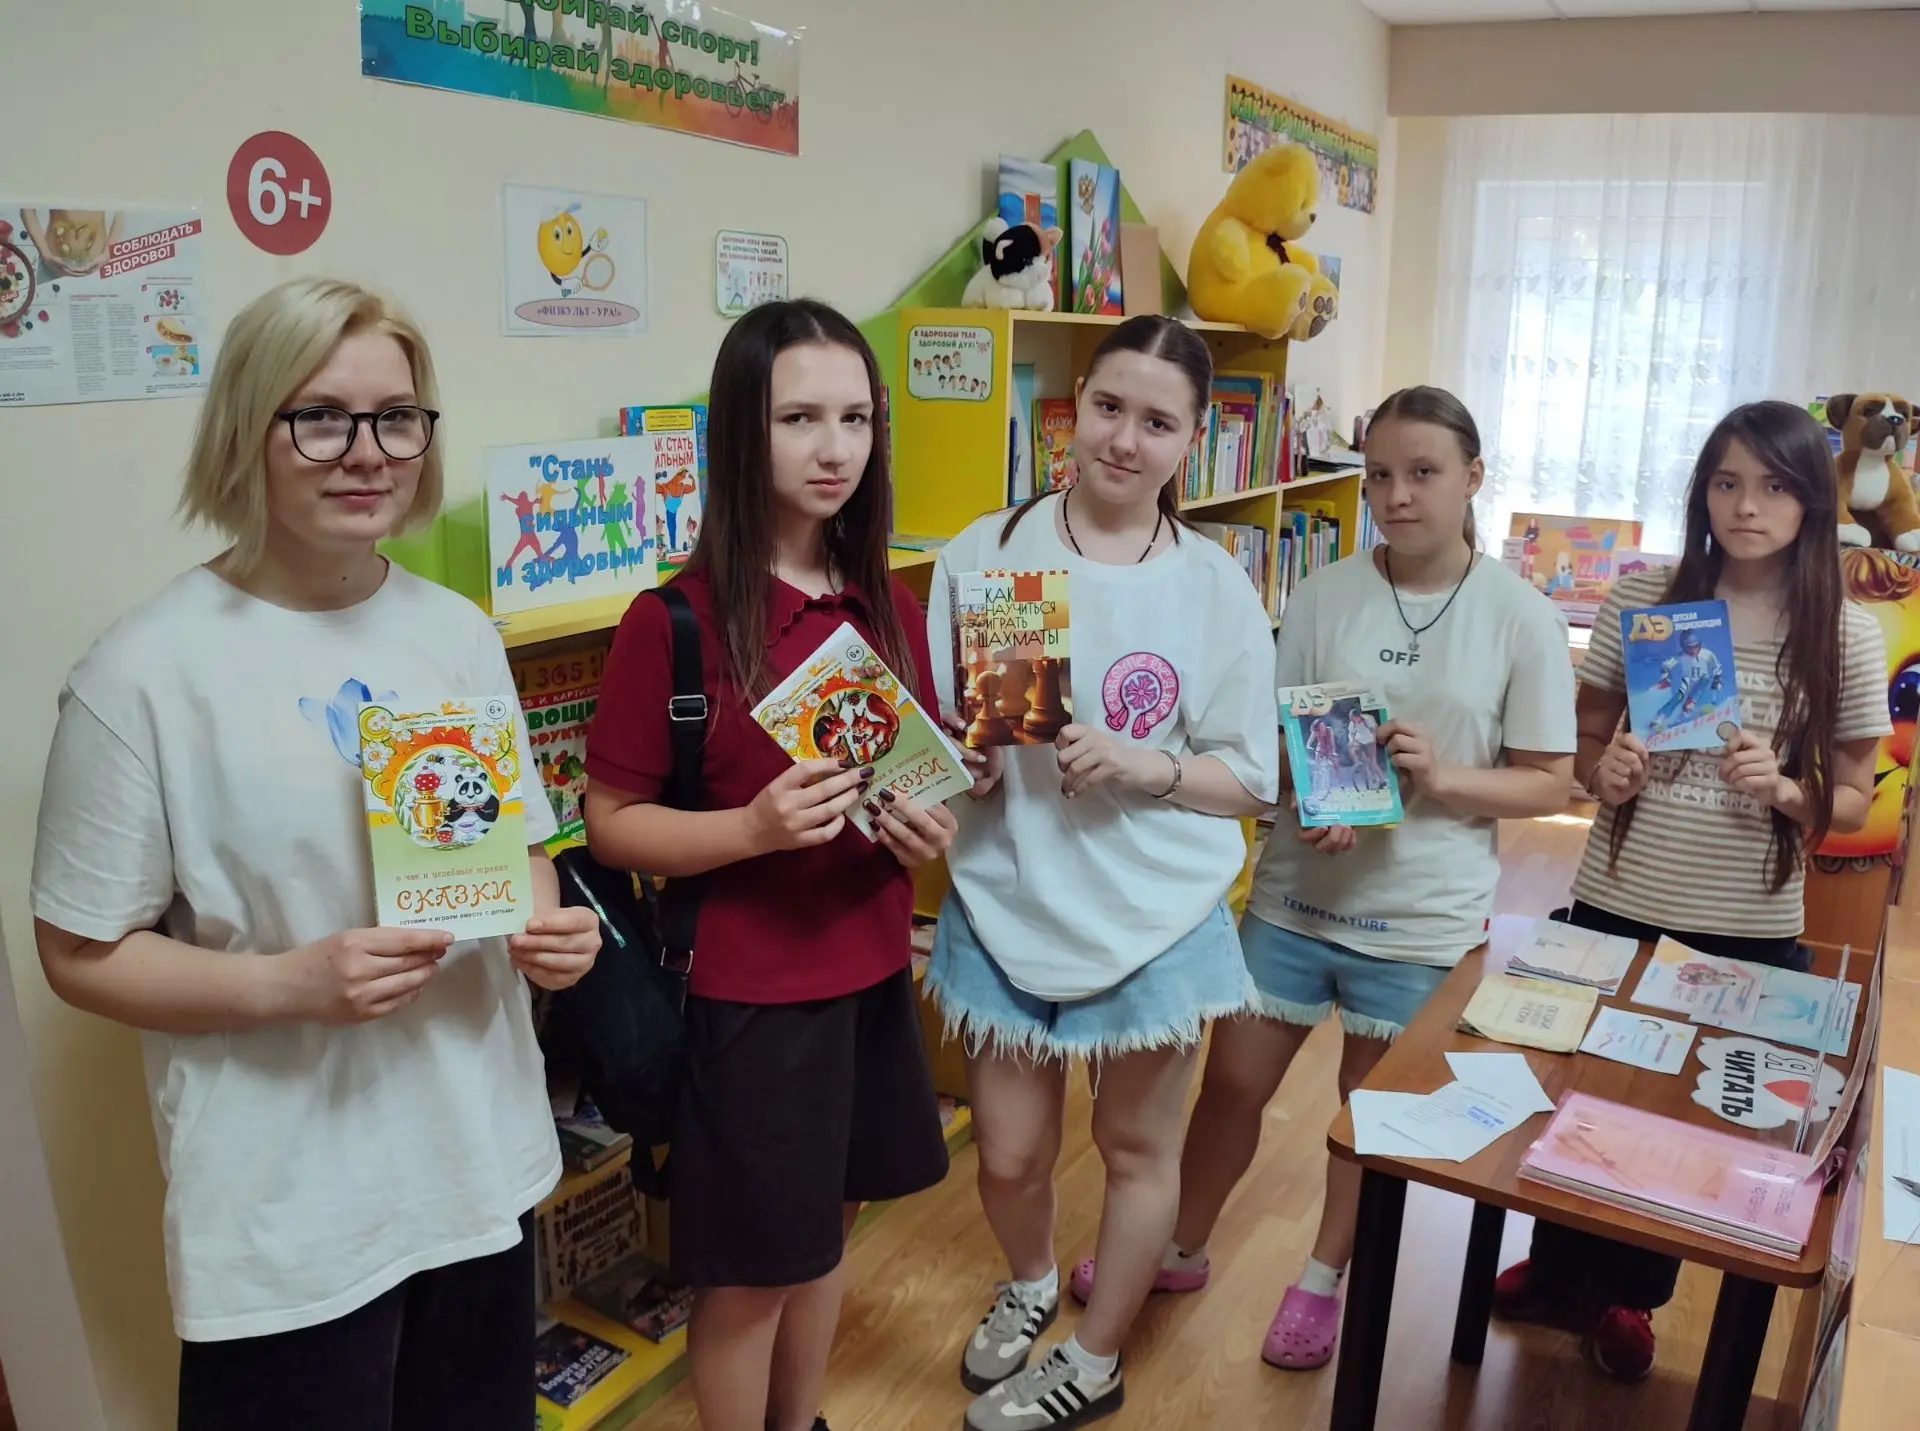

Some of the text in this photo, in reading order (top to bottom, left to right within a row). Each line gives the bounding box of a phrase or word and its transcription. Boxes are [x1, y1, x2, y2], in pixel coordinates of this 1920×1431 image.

[405, 6, 599, 74] Выбирай
[661, 20, 759, 66] спорт!
[249, 157, 322, 225] 6+
[112, 223, 195, 257] СОБЛЮДАТЬ
[102, 245, 172, 275] ЗДОРОВО!
[919, 339, 957, 348] ЗДОРОВЫЙ
[921, 330, 959, 339] ЗДОРОВОМ
[961, 331, 977, 339] ТЕЛЕ
[667, 437, 693, 452] СТАТЬ
[529, 454, 614, 482] "Стань
[655, 451, 694, 469] ИЛЬНЫМ
[520, 502, 634, 533] сильным
[497, 567, 513, 587] и
[985, 587, 1015, 603] КАК
[986, 602, 1057, 617] НАУЧИТЬСЯ
[986, 616, 1028, 631] ИГРАТЬ
[966, 629, 1059, 649] В ШАХМАТЫ
[849, 649, 860, 660] 6+
[1379, 648, 1420, 667] OFF
[535, 662, 583, 689] 365
[489, 705, 502, 715] 6+
[527, 699, 598, 731] ВОЩИ
[432, 868, 473, 880] целебных
[396, 880, 516, 914] СКАЗКИ
[434, 914, 458, 923] играем
[459, 911, 482, 920] вместе
[490, 908, 515, 917] детьми
[1283, 896, 1389, 932] TEMPERATURE
[1765, 1052, 1818, 1077] Я
[1721, 1050, 1755, 1117] ЧИТАТЬ
